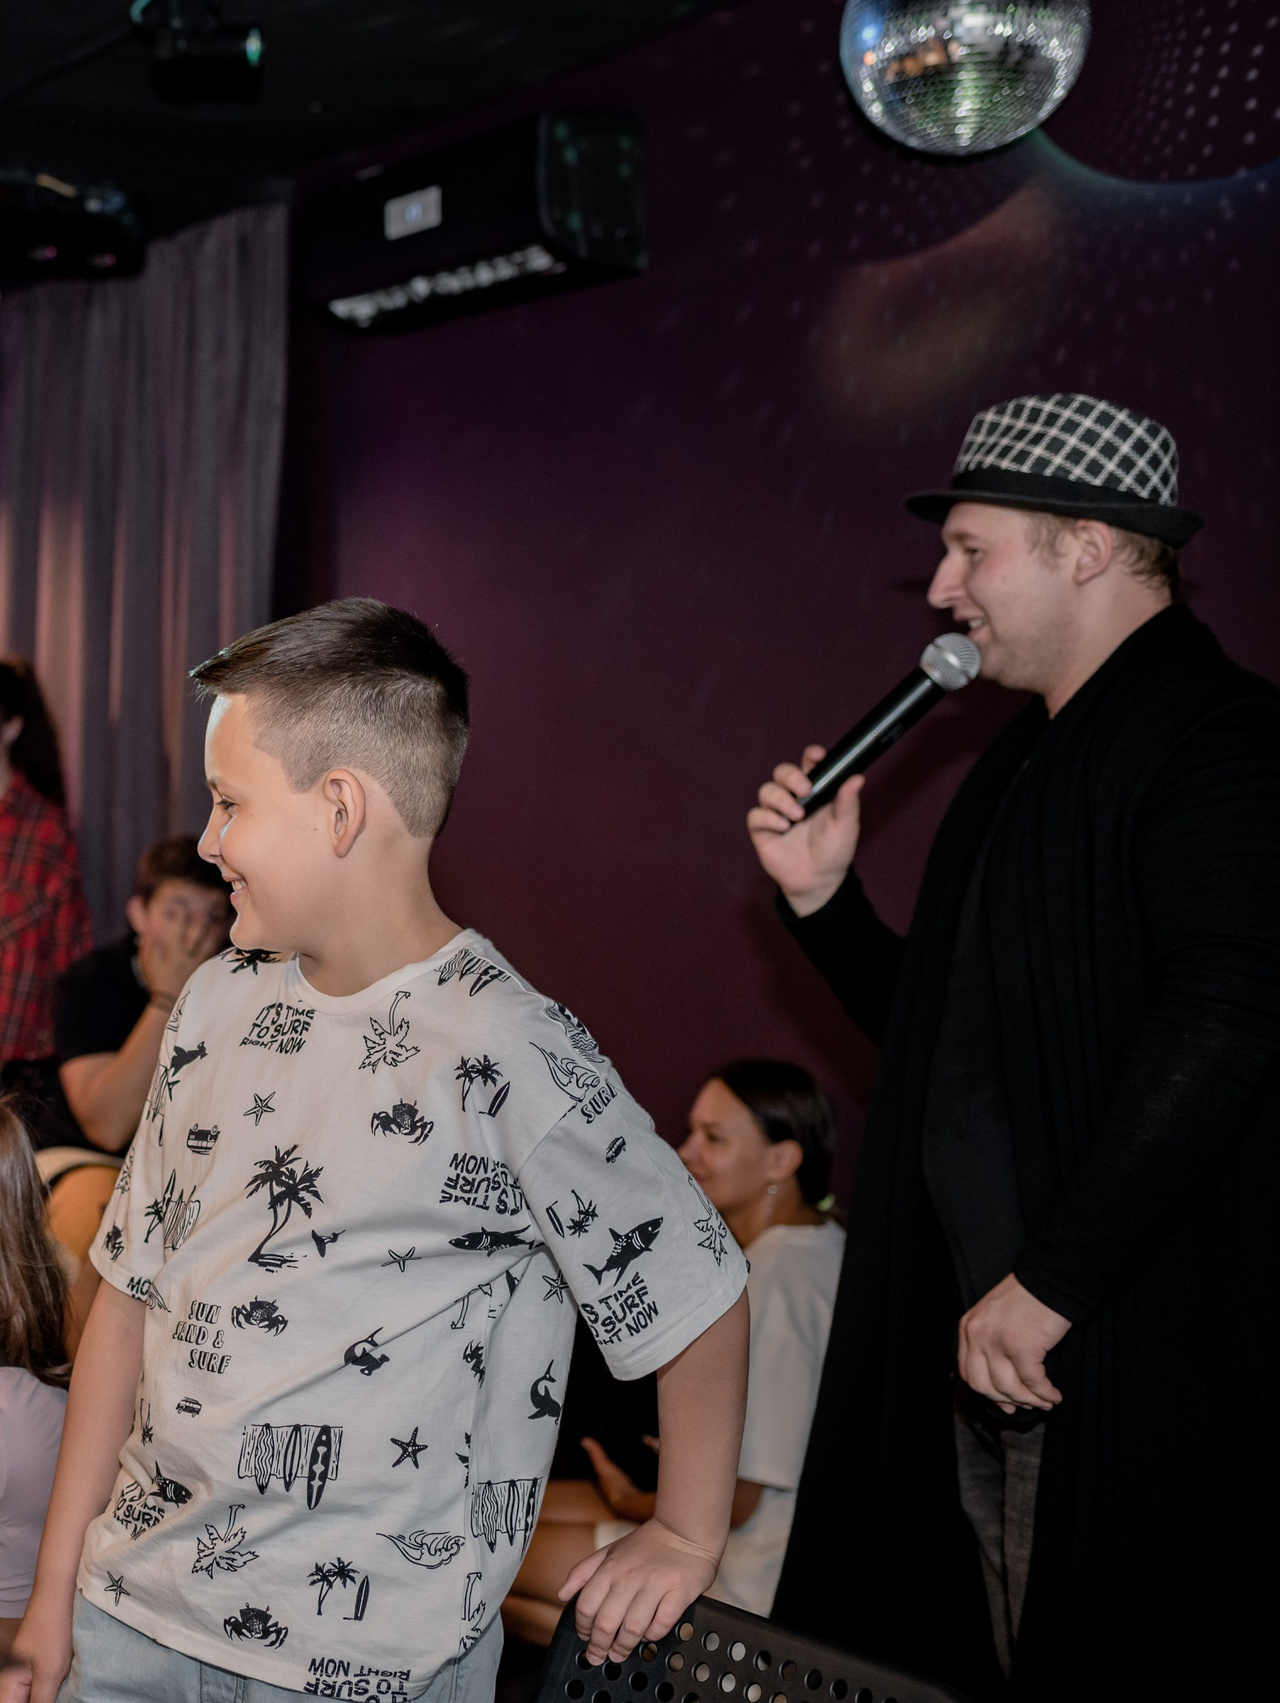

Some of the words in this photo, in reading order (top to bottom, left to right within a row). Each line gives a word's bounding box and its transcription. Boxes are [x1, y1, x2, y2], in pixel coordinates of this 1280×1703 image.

[285, 1005, 316, 1020] TIME
[248, 1022, 270, 1039] TO
[270, 1018, 311, 1039] SURF
[239, 1037, 278, 1050] RIGHT
[275, 1036, 306, 1055] NOW
[448, 1152, 489, 1175] NOW
[443, 1172, 501, 1193] SURF
[439, 1189, 490, 1211] TIME
[598, 1271, 645, 1311] TIME
[188, 1300, 221, 1324] SUN
[600, 1285, 649, 1334] SURF
[625, 1301, 659, 1337] NOW
[172, 1321, 209, 1345] SAND
[188, 1348, 232, 1374] SURF
[308, 1656, 351, 1679] NOW
[353, 1665, 412, 1682] RIGHT
[303, 1677, 370, 1698] SURF
[376, 1678, 408, 1696] TO
